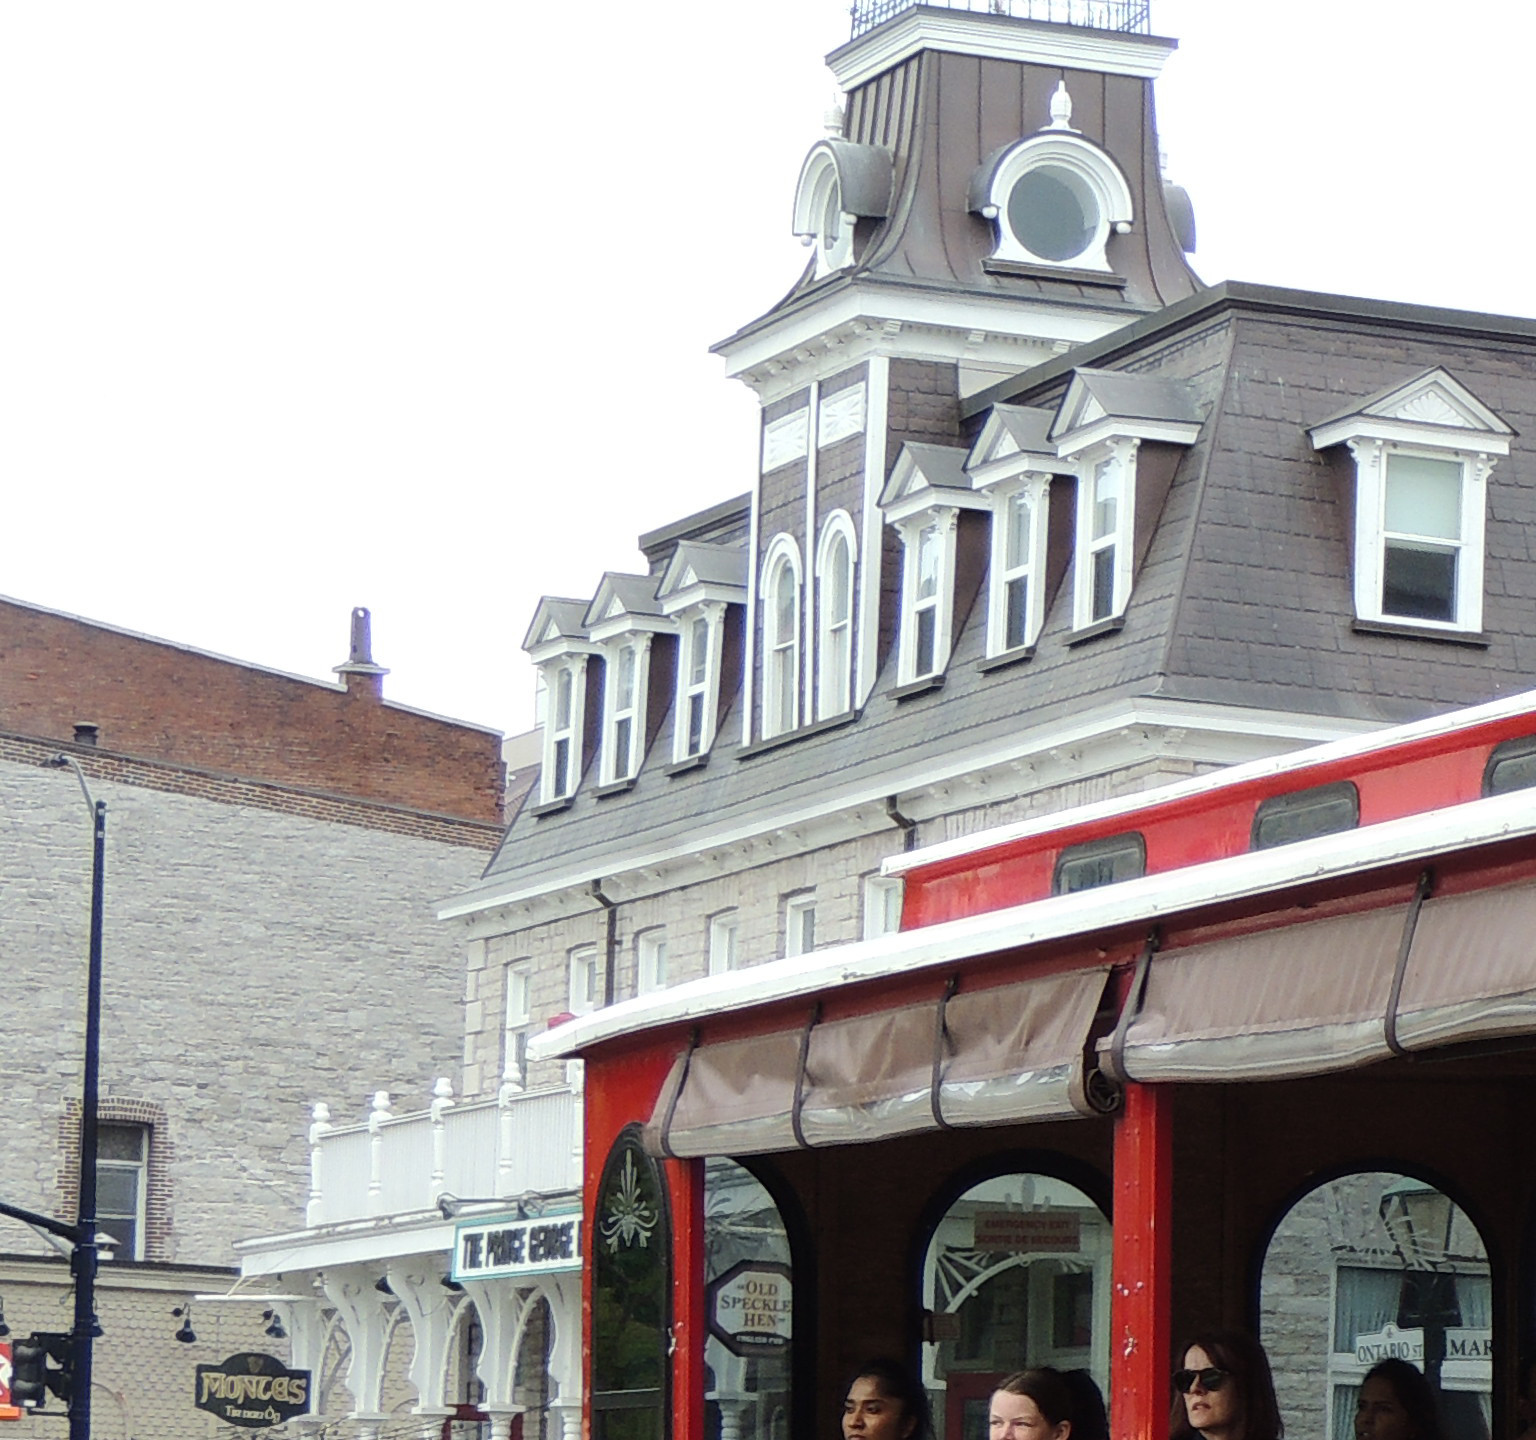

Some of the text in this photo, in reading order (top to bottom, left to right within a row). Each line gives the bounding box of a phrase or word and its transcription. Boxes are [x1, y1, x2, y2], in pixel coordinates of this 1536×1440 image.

[746, 1280, 778, 1296] OLD
[744, 1313, 777, 1327] HEN
[1358, 1342, 1410, 1362] ONTARIO
